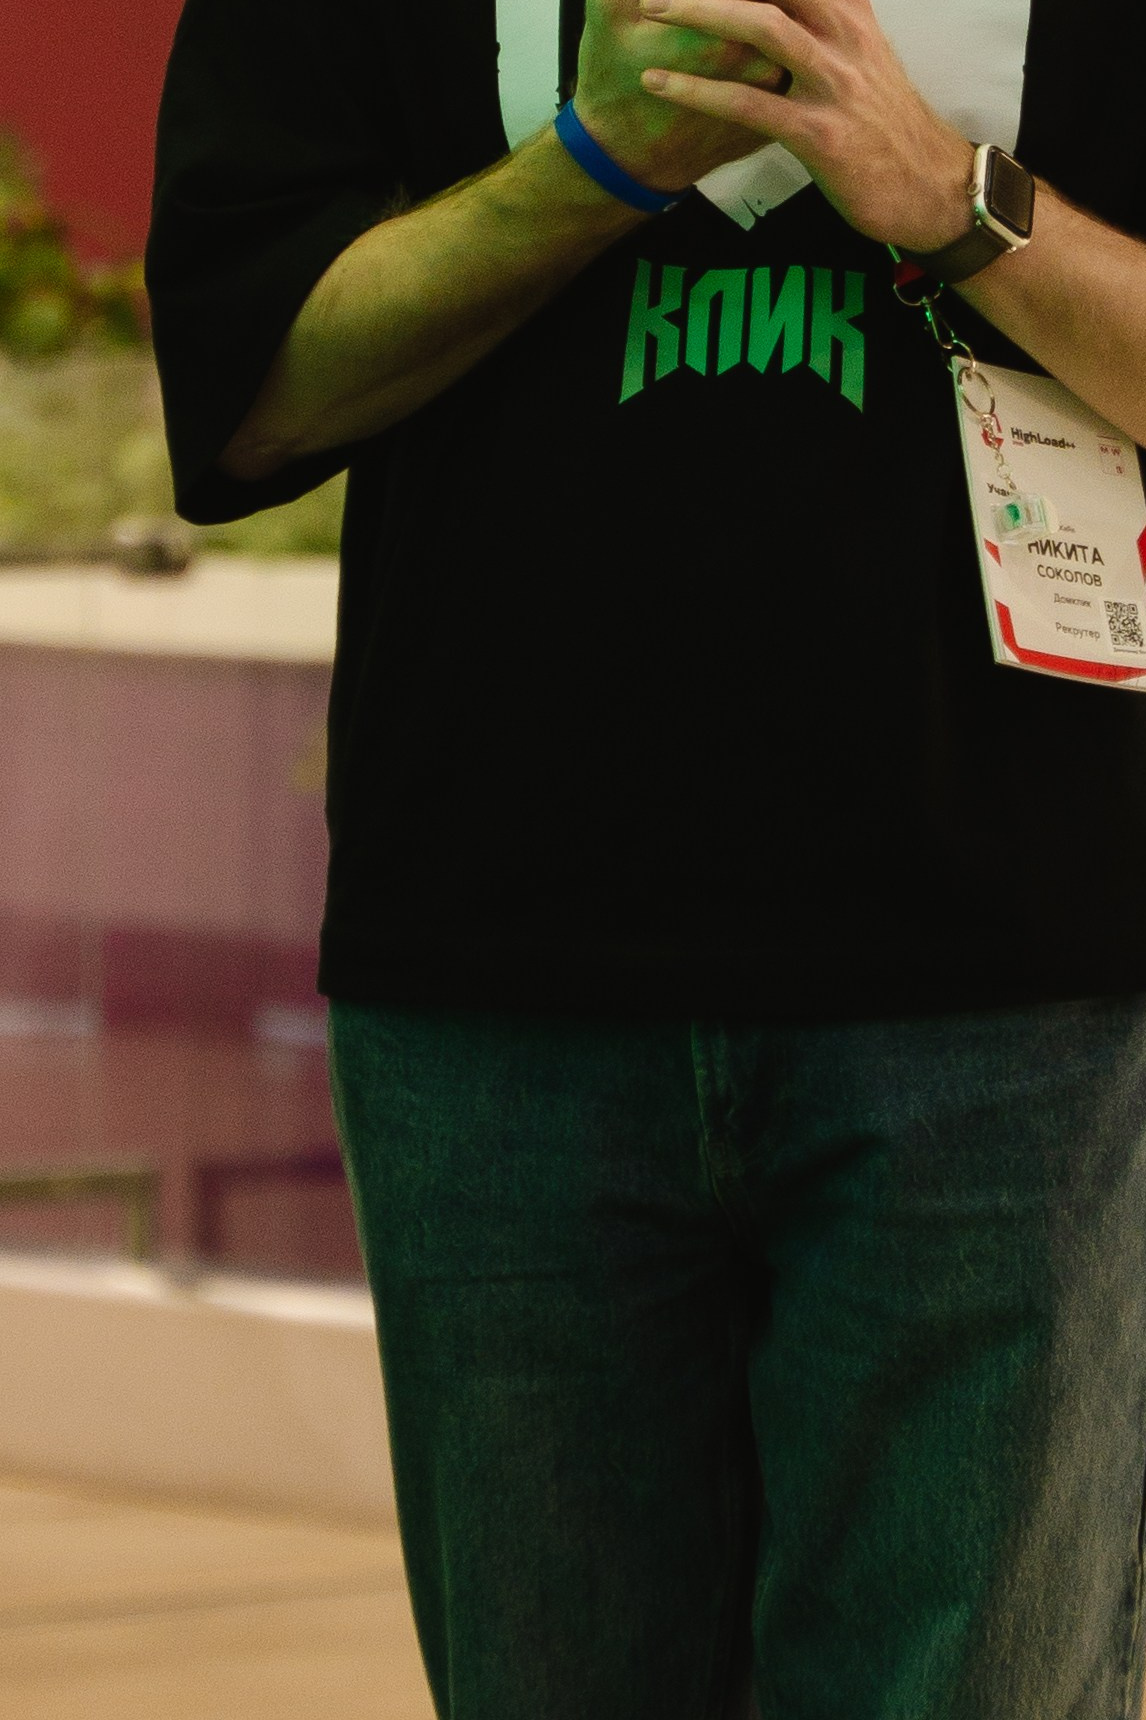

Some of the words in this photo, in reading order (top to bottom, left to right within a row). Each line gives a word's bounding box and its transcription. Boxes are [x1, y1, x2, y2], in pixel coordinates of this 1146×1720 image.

[619, 259, 867, 414] КЛИК
[1010, 427, 1076, 449] HighLoad++
[1037, 564, 1103, 586] СОКОЛОВ
[1055, 622, 1101, 641] Рекрутер
